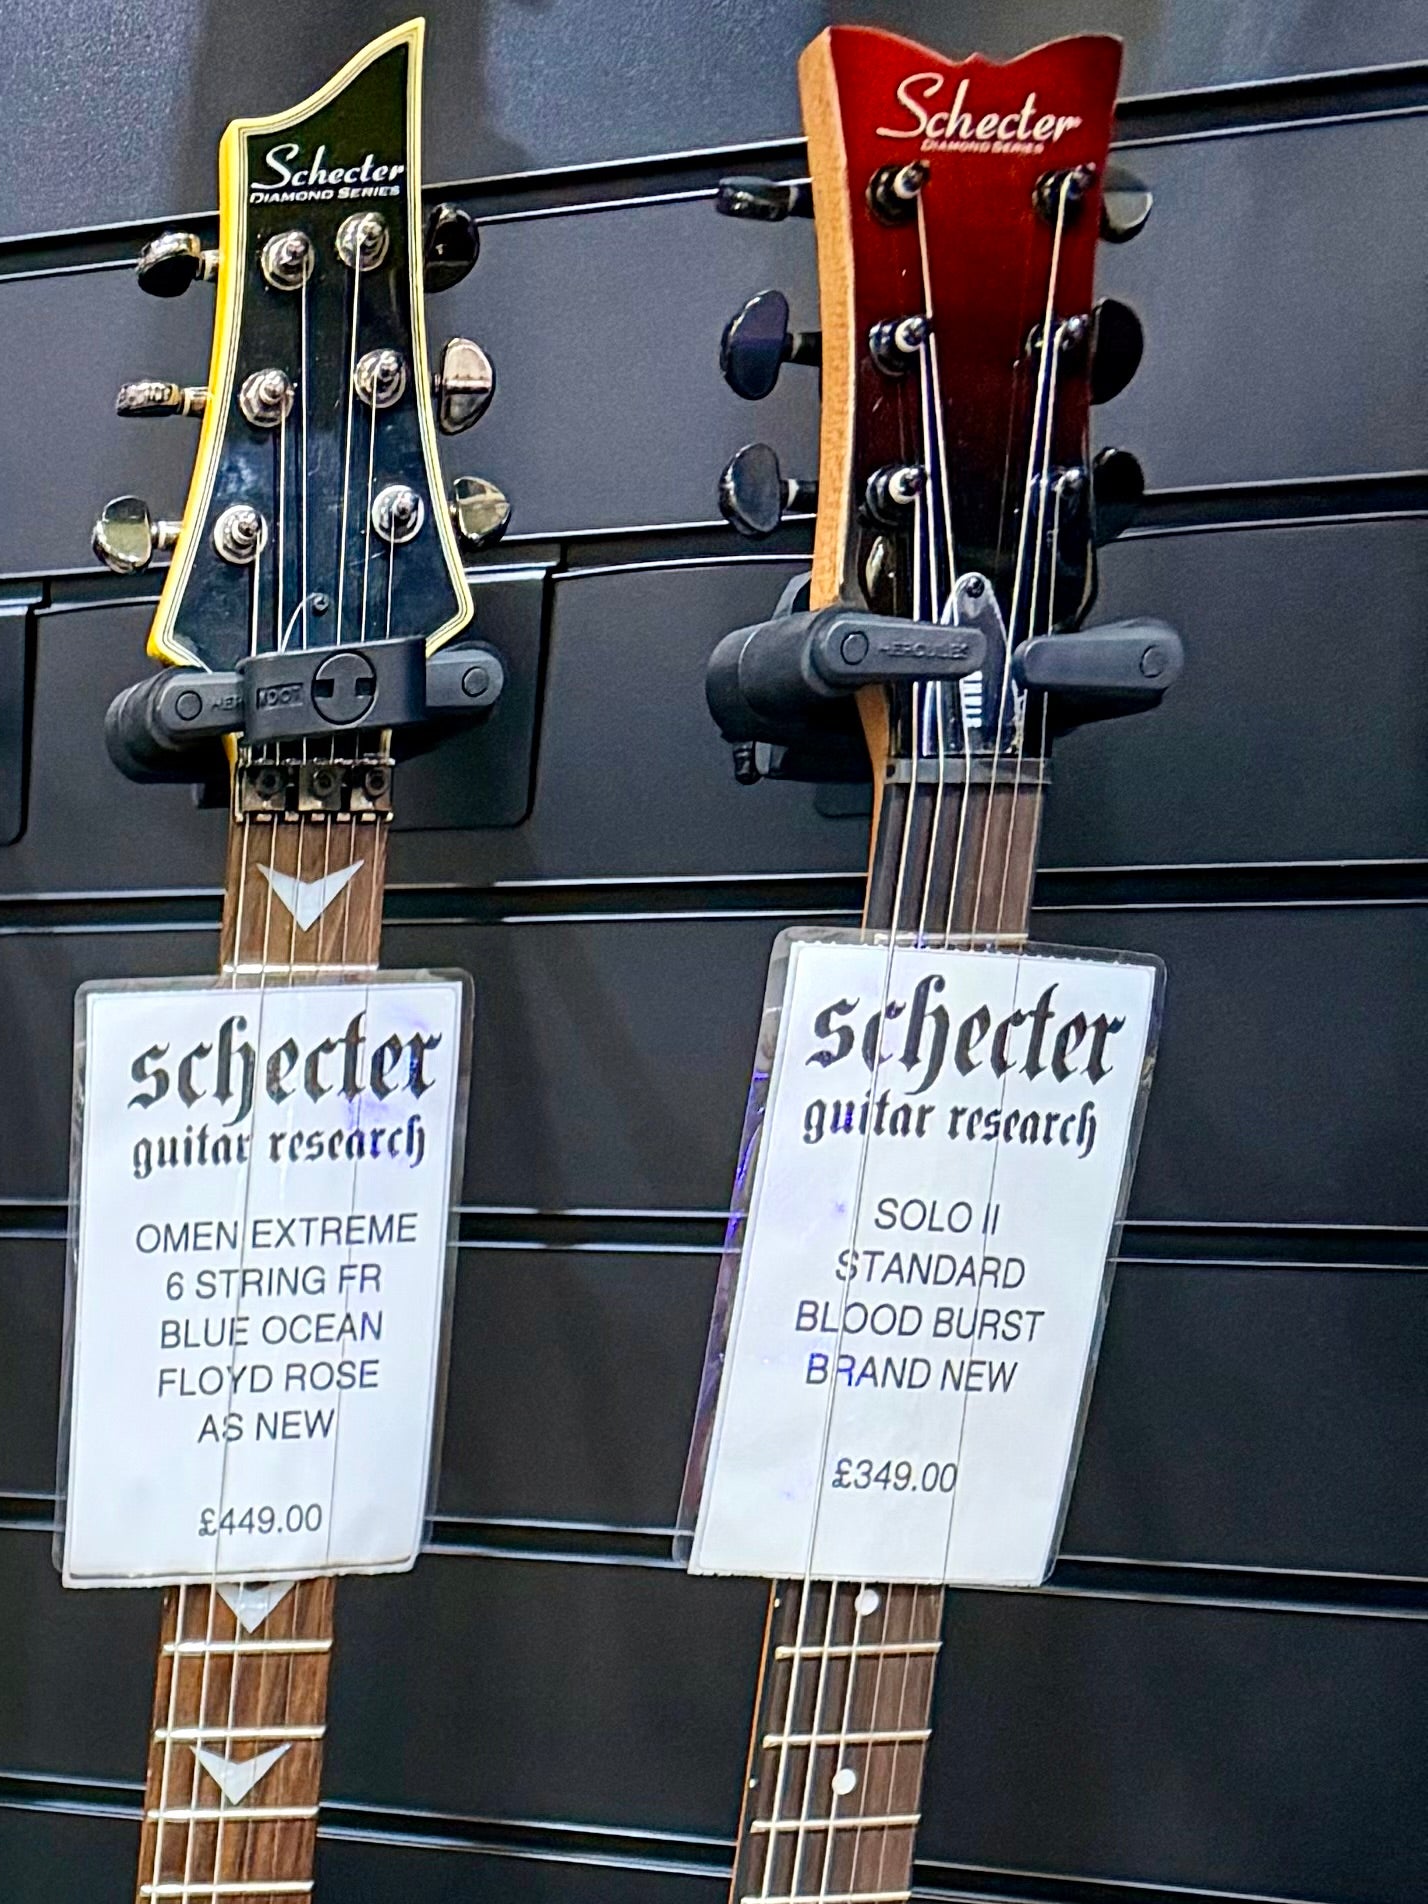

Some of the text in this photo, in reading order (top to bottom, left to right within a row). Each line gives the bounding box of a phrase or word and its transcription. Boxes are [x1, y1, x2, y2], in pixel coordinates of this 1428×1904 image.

[876, 72, 1083, 143] Schecter
[250, 143, 405, 189] Schecter
[249, 185, 401, 204] DIAMOND SERIES
[806, 974, 1126, 1096] schecter
[127, 1010, 442, 1127] schecter
[803, 1090, 1098, 1159] guitar research
[132, 1114, 426, 1180] guitar research
[136, 1212, 419, 1255] OMEN EXTREME
[875, 1198, 1000, 1236] SOLO II
[165, 1263, 382, 1301] 6 STRING FR
[835, 1249, 1026, 1291] STANDARD
[160, 1310, 384, 1351] BLUE OCEAN
[795, 1301, 1045, 1344] BLOOD BURST
[158, 1359, 380, 1398] FLOYD ROSE
[806, 1353, 1019, 1394] BRAND NEW
[198, 1408, 336, 1444] AS NEW
[832, 1458, 959, 1494] £349.00
[198, 1503, 324, 1537] £449.00
